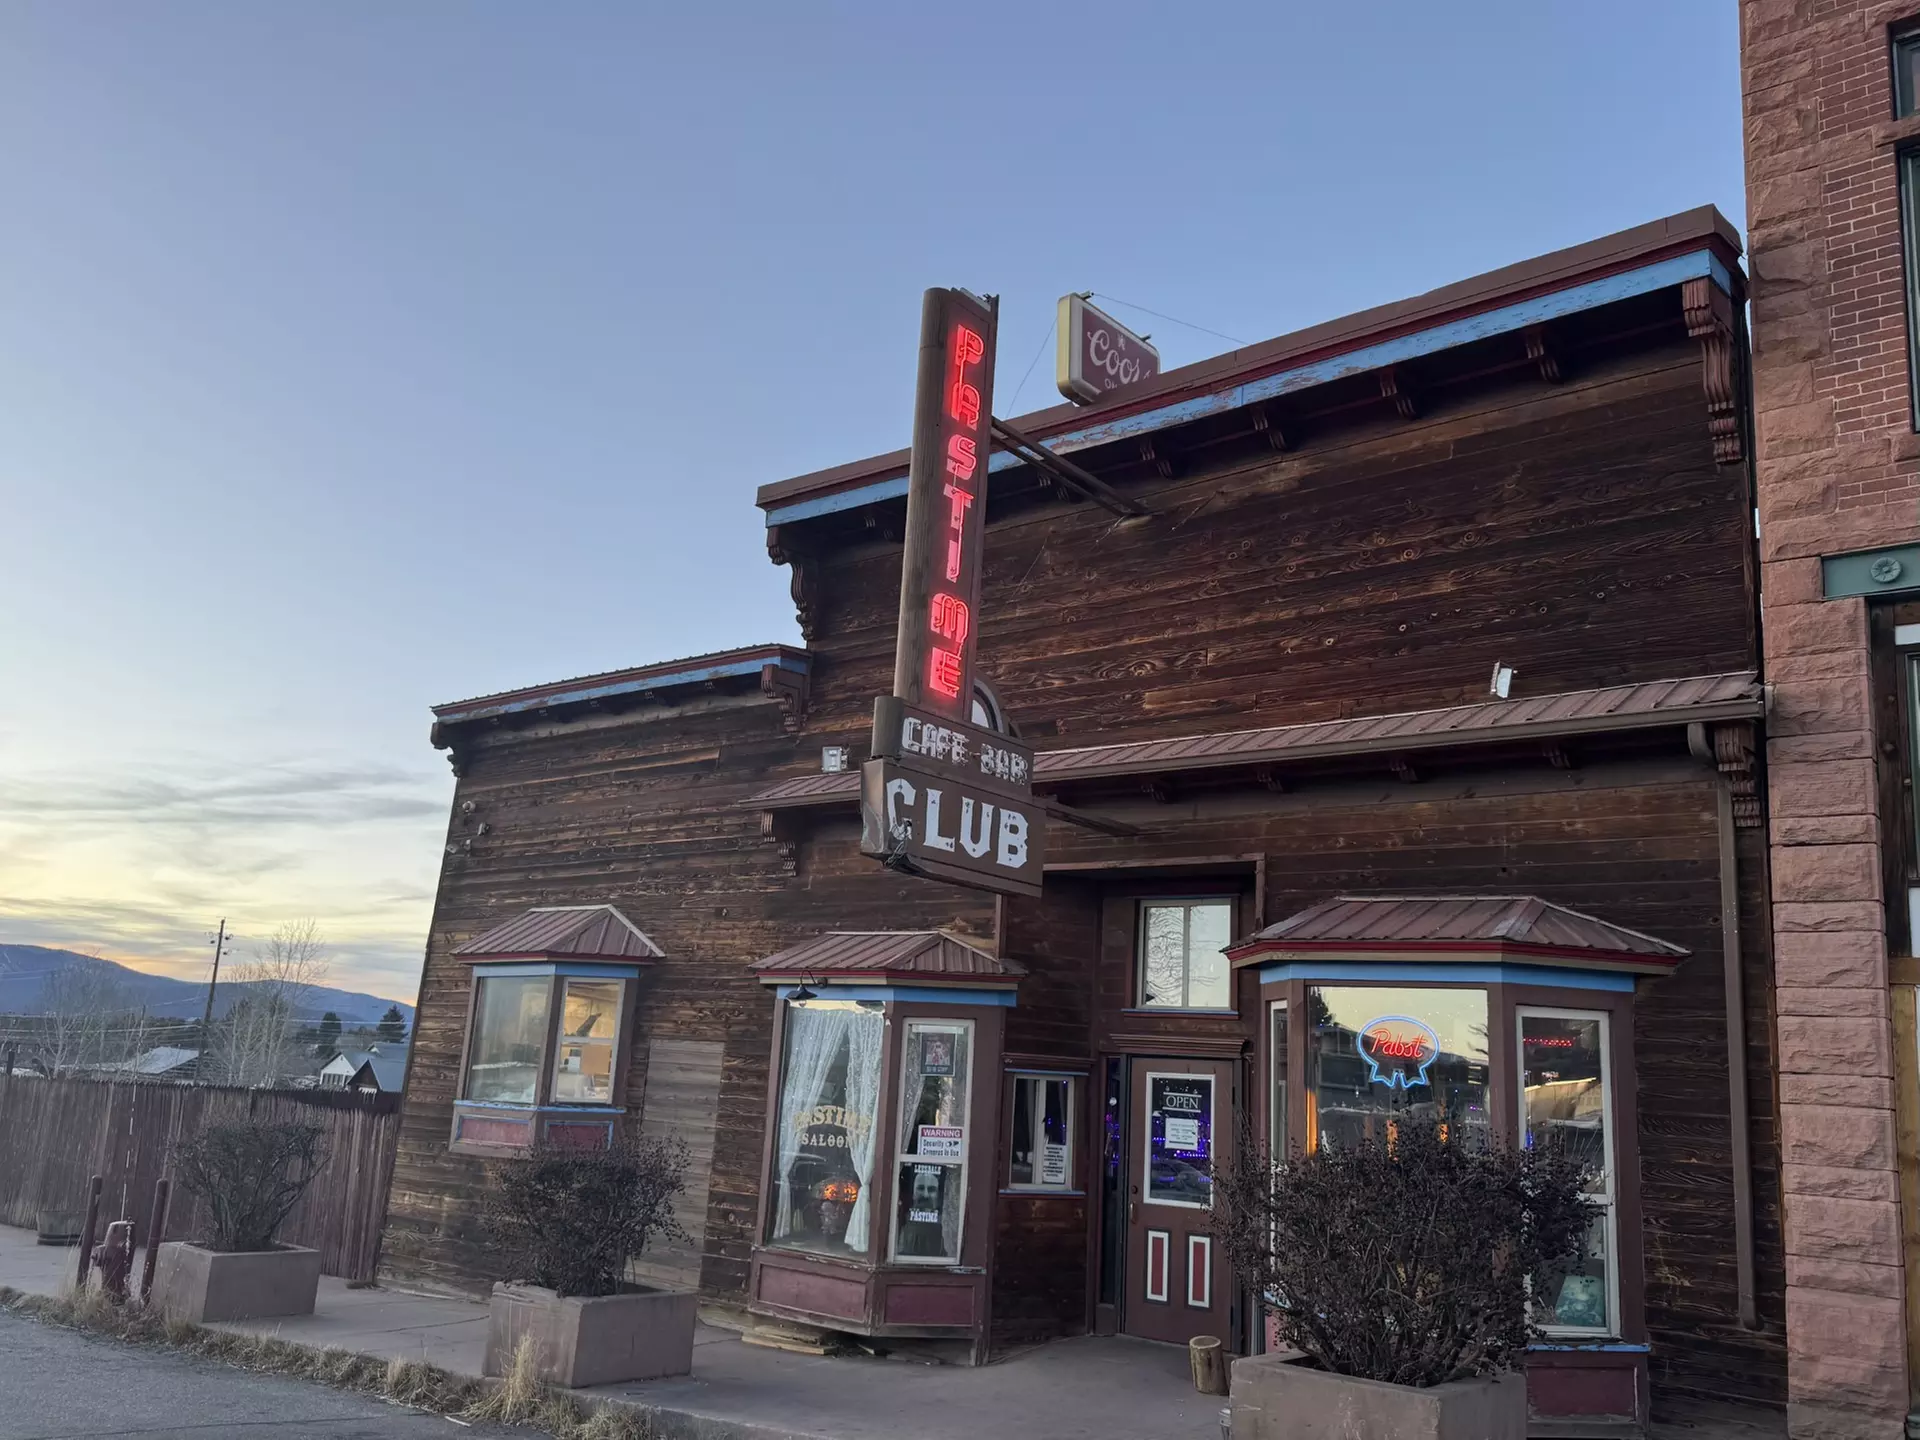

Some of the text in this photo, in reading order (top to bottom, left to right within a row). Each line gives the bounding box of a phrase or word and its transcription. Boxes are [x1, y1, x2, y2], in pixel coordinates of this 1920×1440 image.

[1086, 329, 1152, 385] Coor
[929, 323, 985, 699] PASTIME
[902, 716, 1029, 786] CAFE BAR
[886, 778, 1029, 869] CLUB
[1371, 1028, 1428, 1057] Pabst
[1166, 1095, 1199, 1109] OPEN
[922, 1128, 961, 1138] WARNING
[923, 1139, 944, 1149] Security
